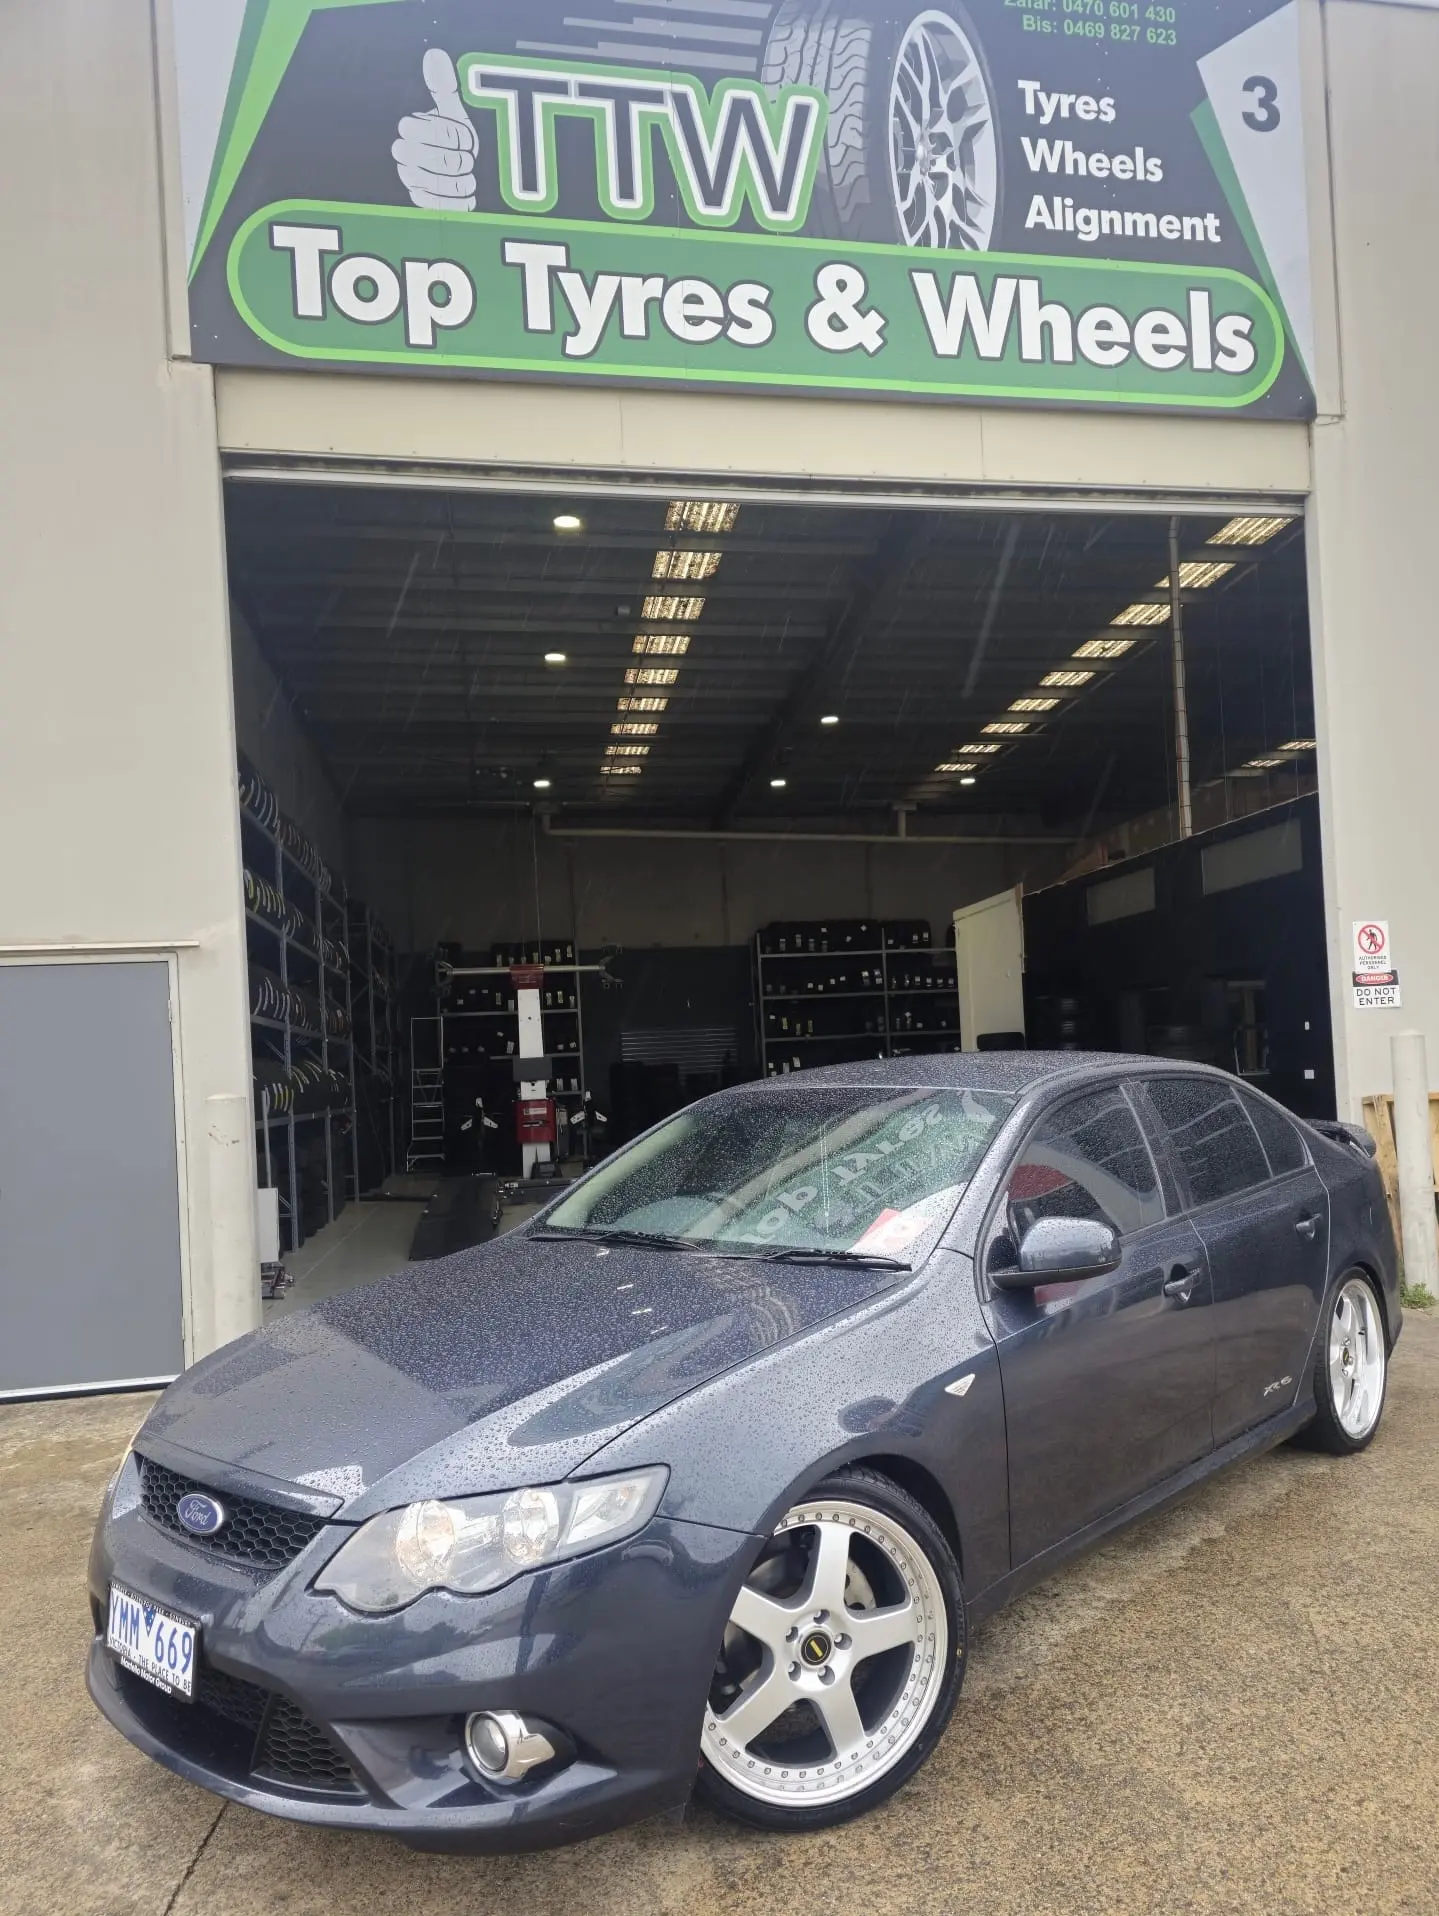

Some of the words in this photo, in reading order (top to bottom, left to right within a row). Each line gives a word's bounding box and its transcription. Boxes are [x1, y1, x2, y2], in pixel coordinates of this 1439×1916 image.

[1022, 14, 1058, 33] Bis:
[1063, 19, 1105, 38] 0469
[1110, 24, 1141, 41] 827
[1146, 28, 1177, 45] 623
[1063, 0, 1104, 16] 0470
[1109, 2, 1139, 20] 601
[1145, 6, 1176, 23] 430
[1018, 79, 1116, 125] Tyres
[1241, 75, 1281, 132] 3
[467, 63, 819, 220] TTW
[1020, 136, 1164, 184] Wheels
[1024, 195, 1221, 242] Alignment
[270, 225, 475, 347] Top
[504, 241, 774, 357] Tyres
[806, 263, 887, 355] &
[911, 271, 1256, 373] Wheels
[1356, 988, 1371, 996] DO
[1375, 987, 1396, 996] NOT
[1359, 996, 1394, 1006] ENTER
[185, 1499, 212, 1526] Ford
[110, 1588, 140, 1650] YMM
[154, 1620, 192, 1674] 669
[139, 1654, 149, 1669] THE
[151, 1659, 169, 1681] PLACE
[172, 1671, 180, 1686] TO
[183, 1678, 192, 1694] BE
